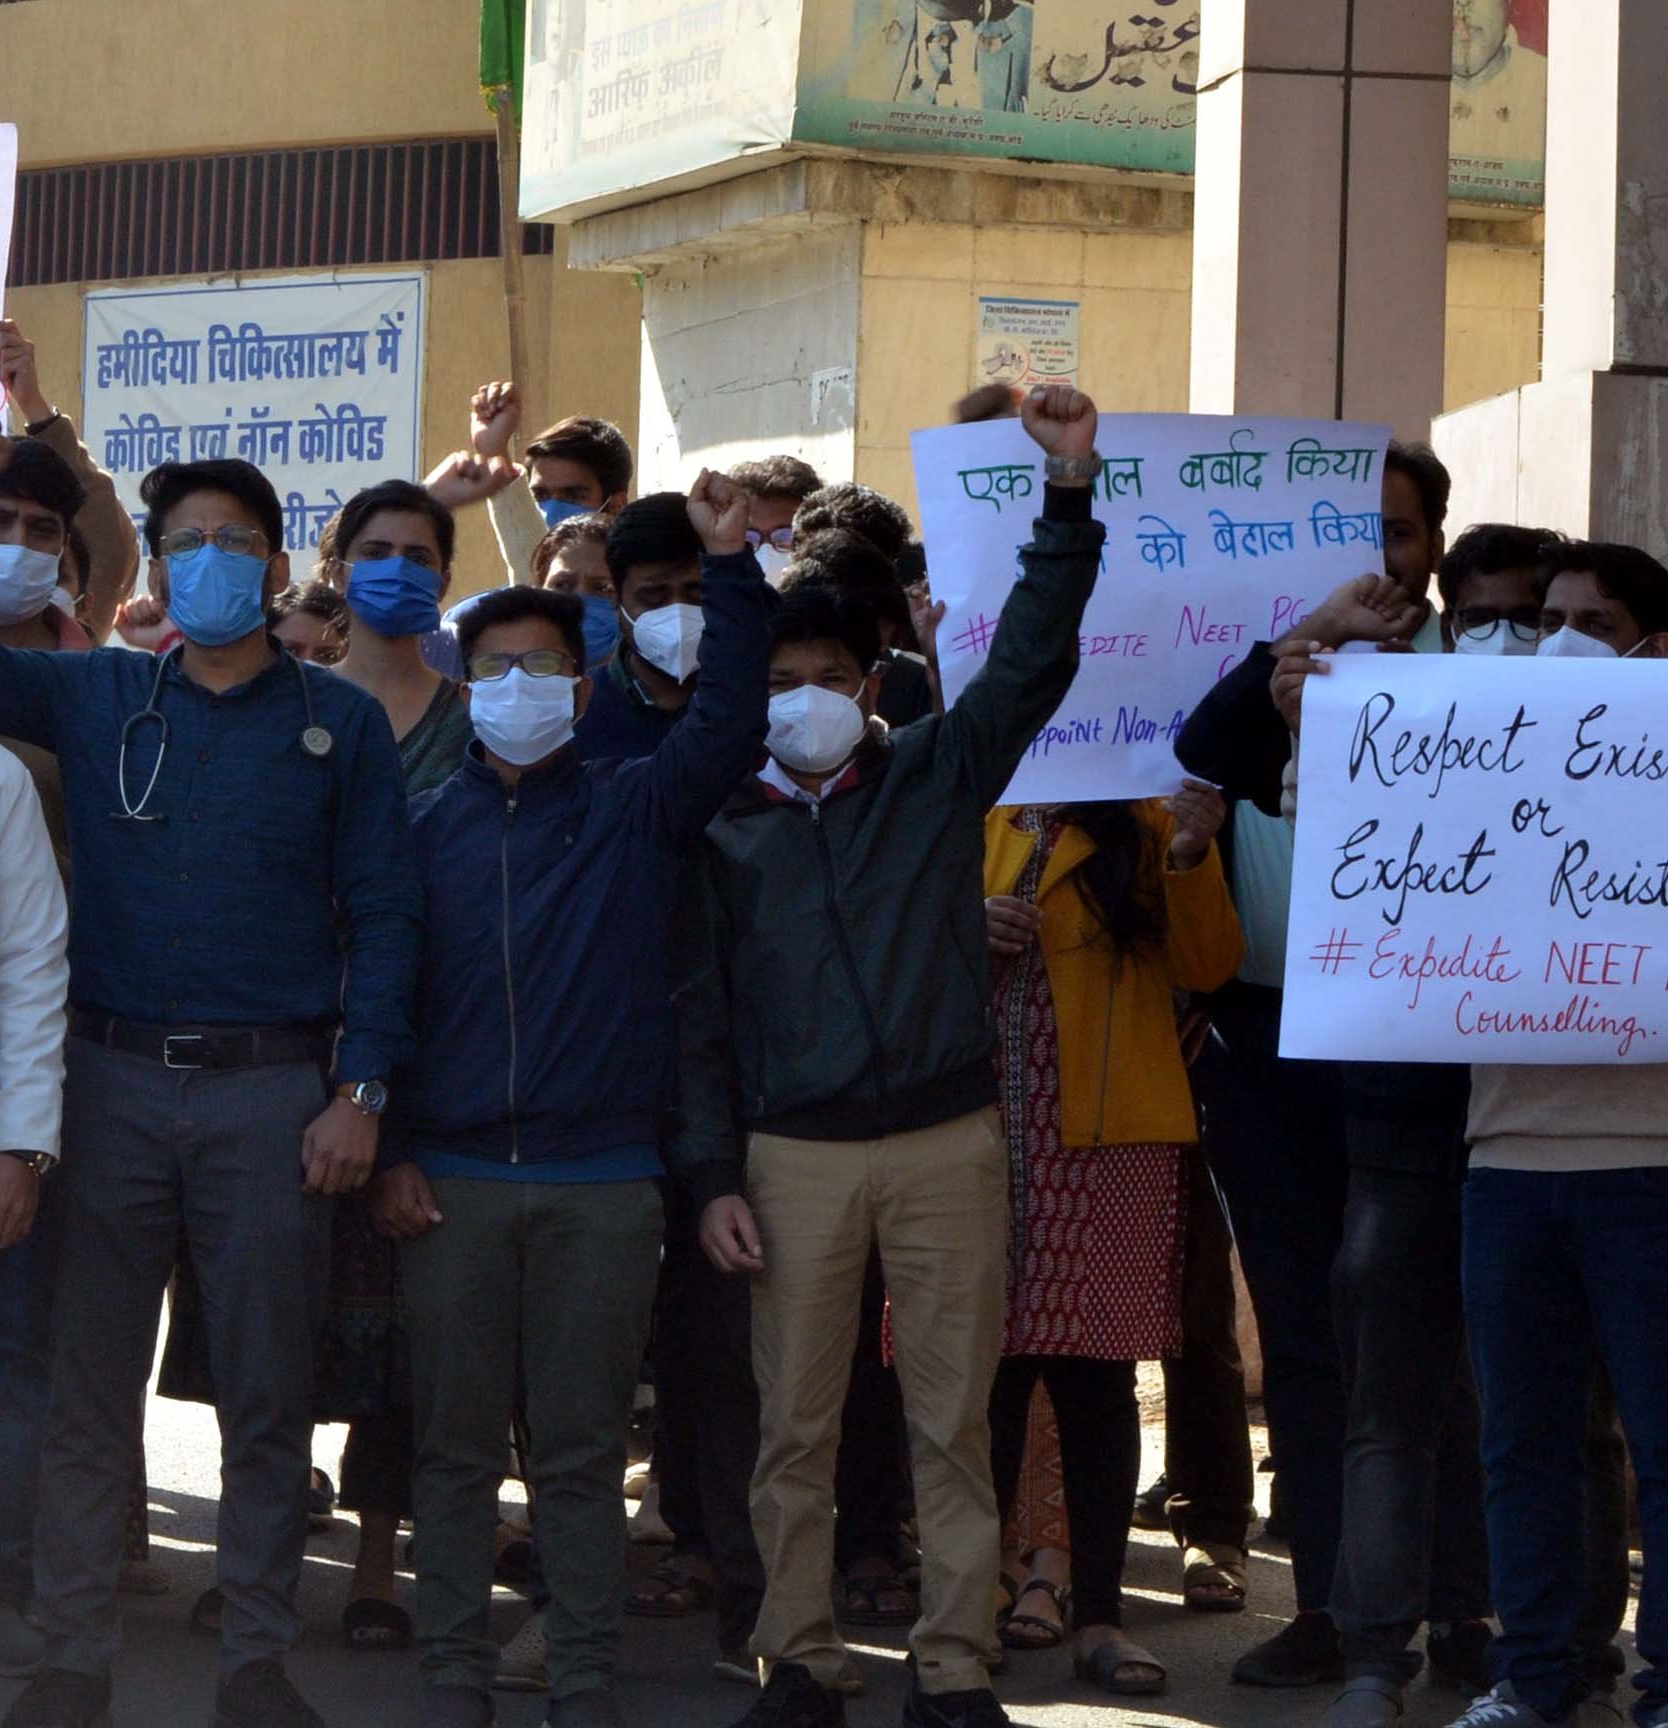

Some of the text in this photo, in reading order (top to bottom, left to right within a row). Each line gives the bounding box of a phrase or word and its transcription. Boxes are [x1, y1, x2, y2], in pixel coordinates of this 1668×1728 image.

[97, 311, 405, 388] हमीदिया चिकित्सालय में
[105, 413, 182, 473] कोविड
[237, 406, 292, 466] नॉन
[299, 403, 387, 464] कोविड
[958, 464, 1035, 513] एक
[1091, 456, 1143, 502] ाल
[1286, 438, 1377, 484] किया
[1136, 515, 1186, 572] को
[1308, 500, 1383, 550] किया
[1175, 605, 1247, 649] NEET
[1111, 705, 1187, 745] Non-A
[1349, 692, 1537, 799] Respect
[1511, 797, 1563, 838] or
[1331, 819, 1668, 926] Expect Resist
[1544, 942, 1652, 985] NEET
